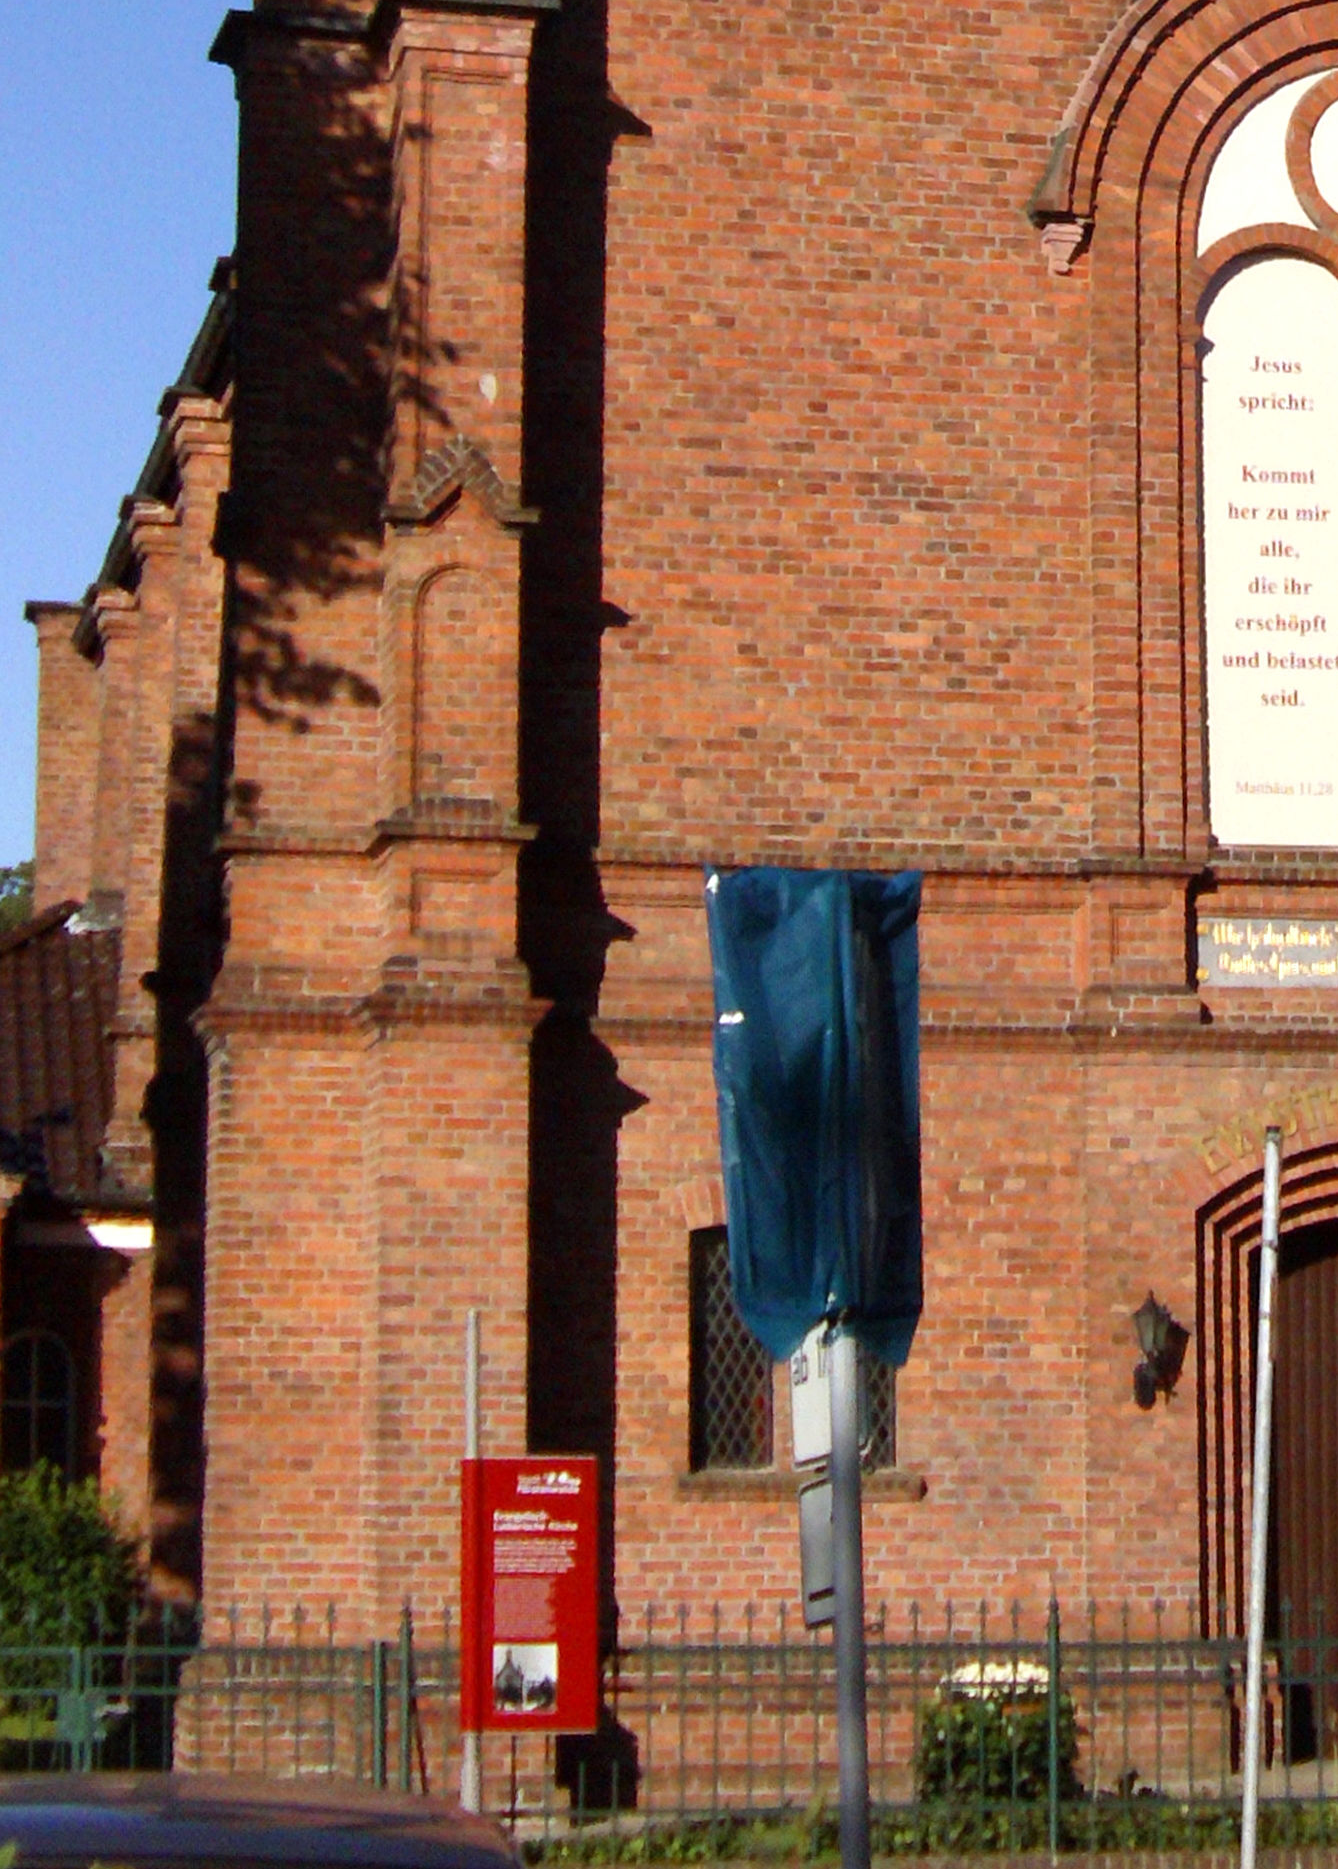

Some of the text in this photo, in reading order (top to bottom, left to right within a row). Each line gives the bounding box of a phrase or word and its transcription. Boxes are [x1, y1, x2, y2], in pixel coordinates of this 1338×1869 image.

[1250, 356, 1302, 374] Jesus
[1239, 393, 1313, 413] spricht:
[1242, 465, 1314, 484] Kommt
[1228, 502, 1331, 521] her zu mir
[1260, 540, 1300, 559] alle,
[1248, 577, 1312, 595] die ihr
[1235, 614, 1326, 637] erschöpft
[1223, 652, 1259, 668] und
[1261, 689, 1304, 707] seid.
